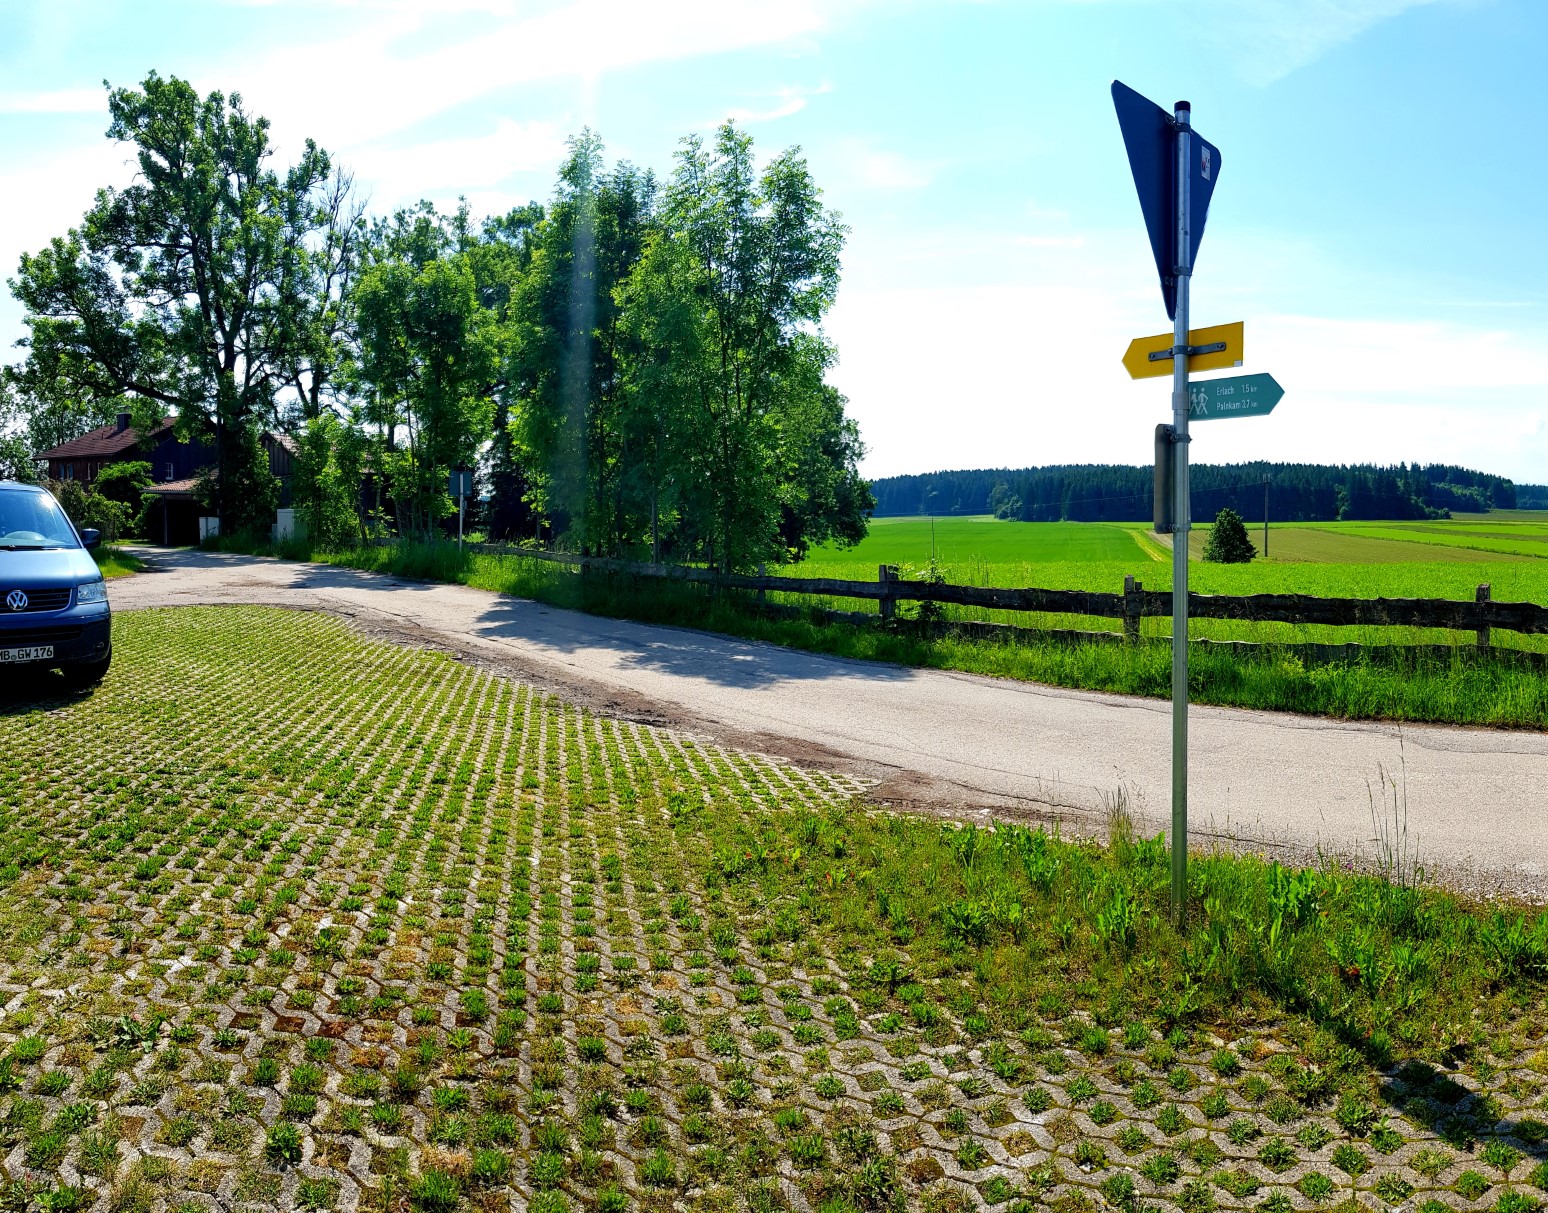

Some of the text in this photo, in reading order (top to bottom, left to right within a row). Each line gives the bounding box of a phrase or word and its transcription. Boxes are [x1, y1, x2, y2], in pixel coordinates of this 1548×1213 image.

[1216, 386, 1235, 395] Erlach
[17, 649, 32, 660] GW
[33, 647, 53, 658] 176
